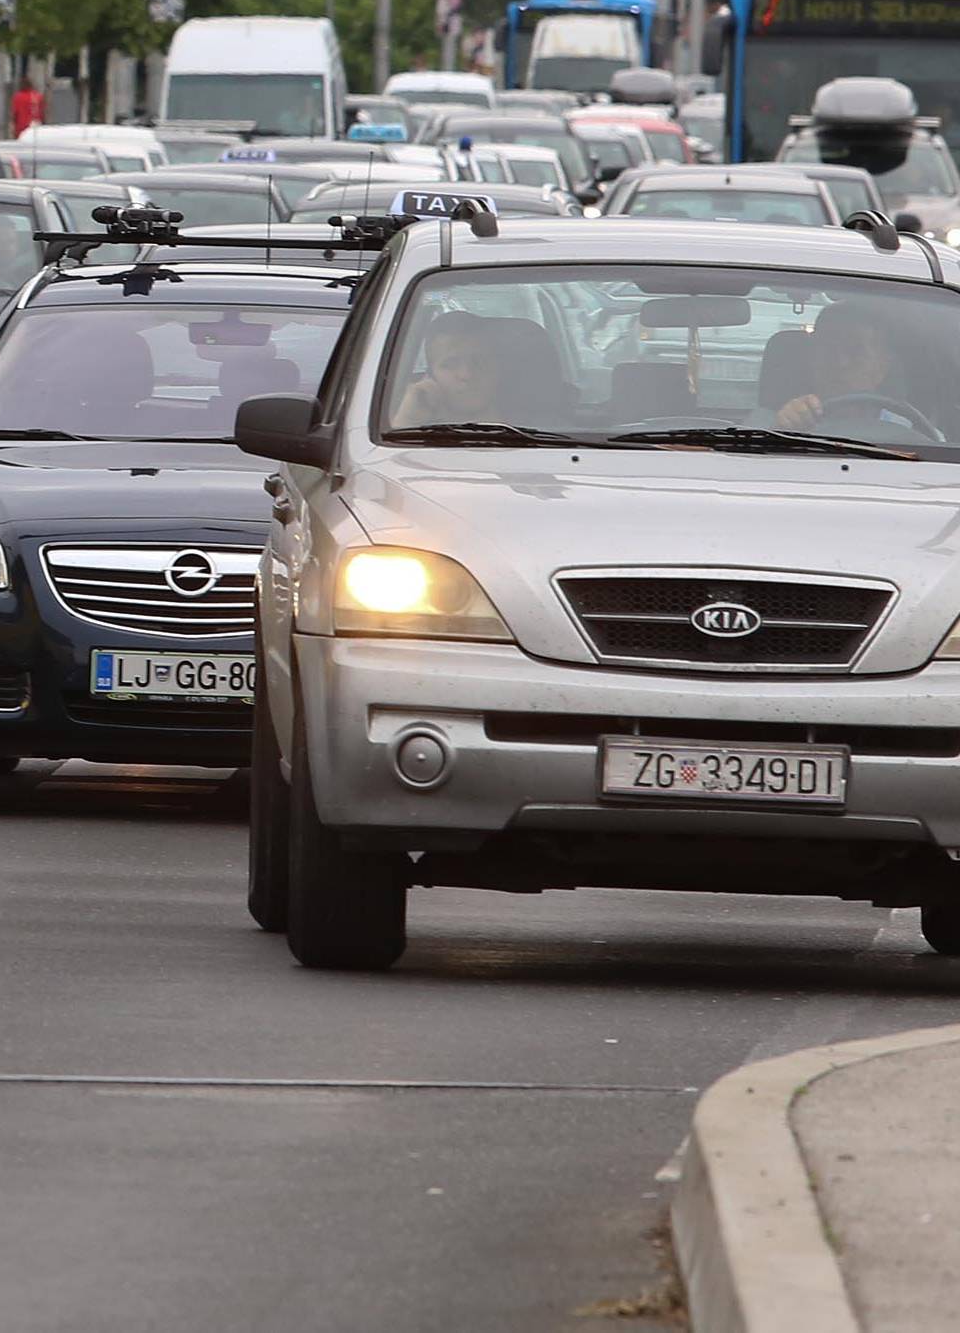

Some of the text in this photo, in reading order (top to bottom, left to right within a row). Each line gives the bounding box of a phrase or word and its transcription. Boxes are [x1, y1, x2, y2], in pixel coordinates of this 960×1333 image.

[703, 610, 750, 629] KIA
[117, 658, 152, 687] LJ
[633, 752, 676, 788] ZG
